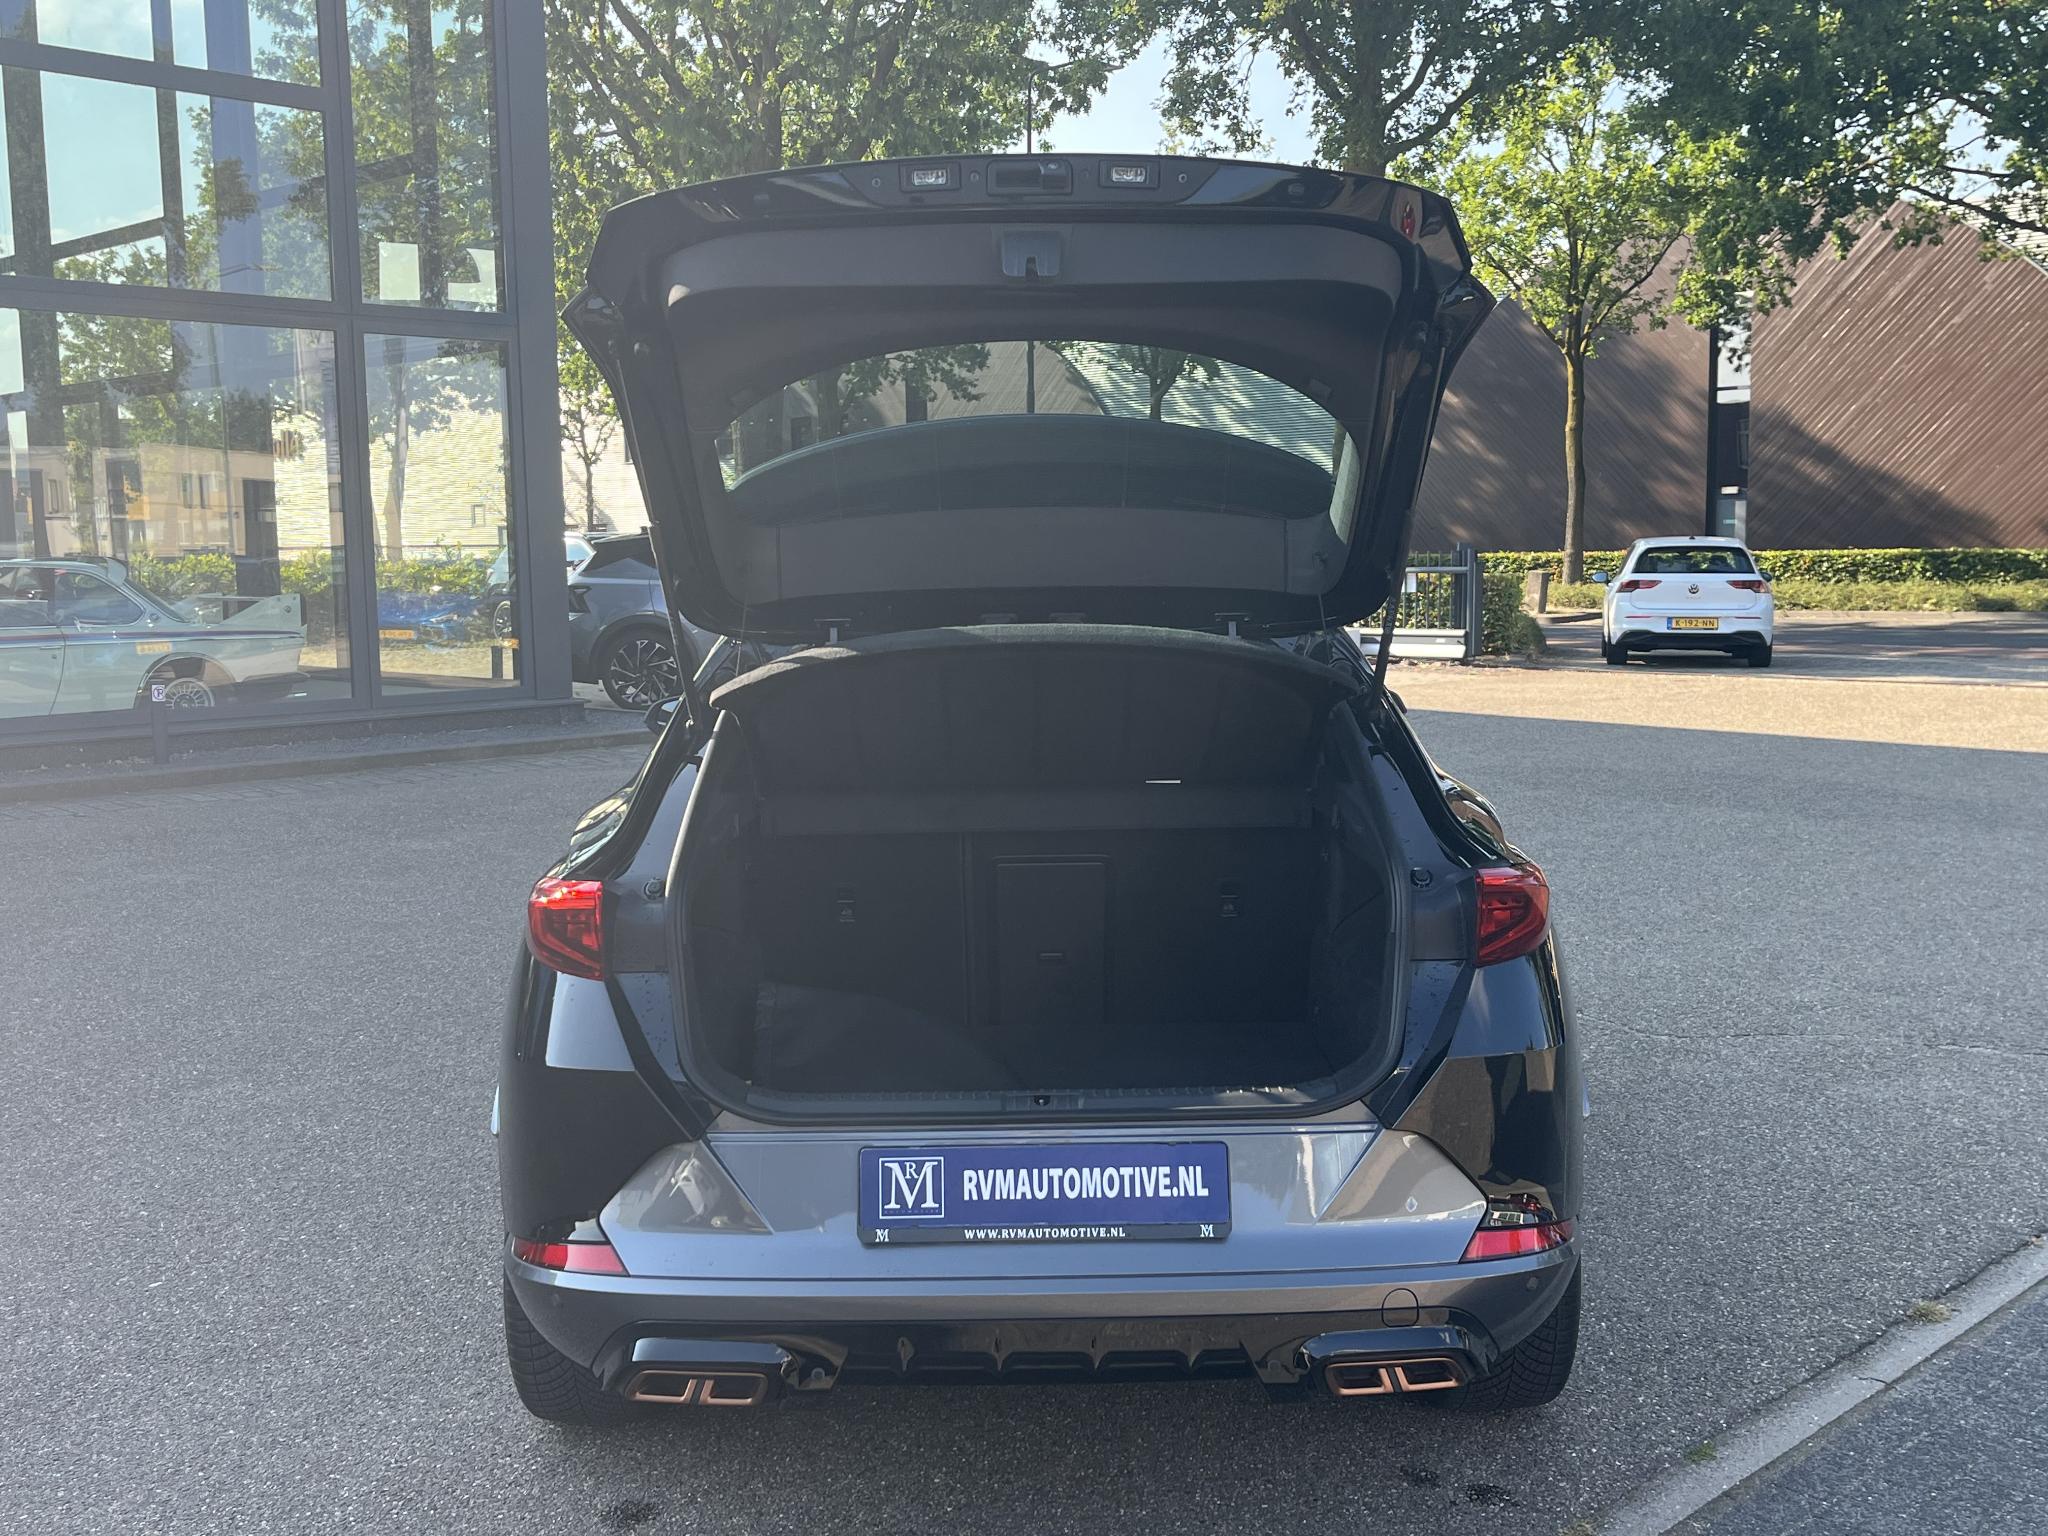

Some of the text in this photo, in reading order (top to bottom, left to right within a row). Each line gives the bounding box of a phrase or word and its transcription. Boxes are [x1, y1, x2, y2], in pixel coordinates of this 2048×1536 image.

[1675, 619, 1715, 627] K-192-NN
[964, 1166, 1209, 1201] RVMAUTOMOTIVE.NL
[965, 1228, 1126, 1241] WWW.RVMAUTOMOTIVE.NL
